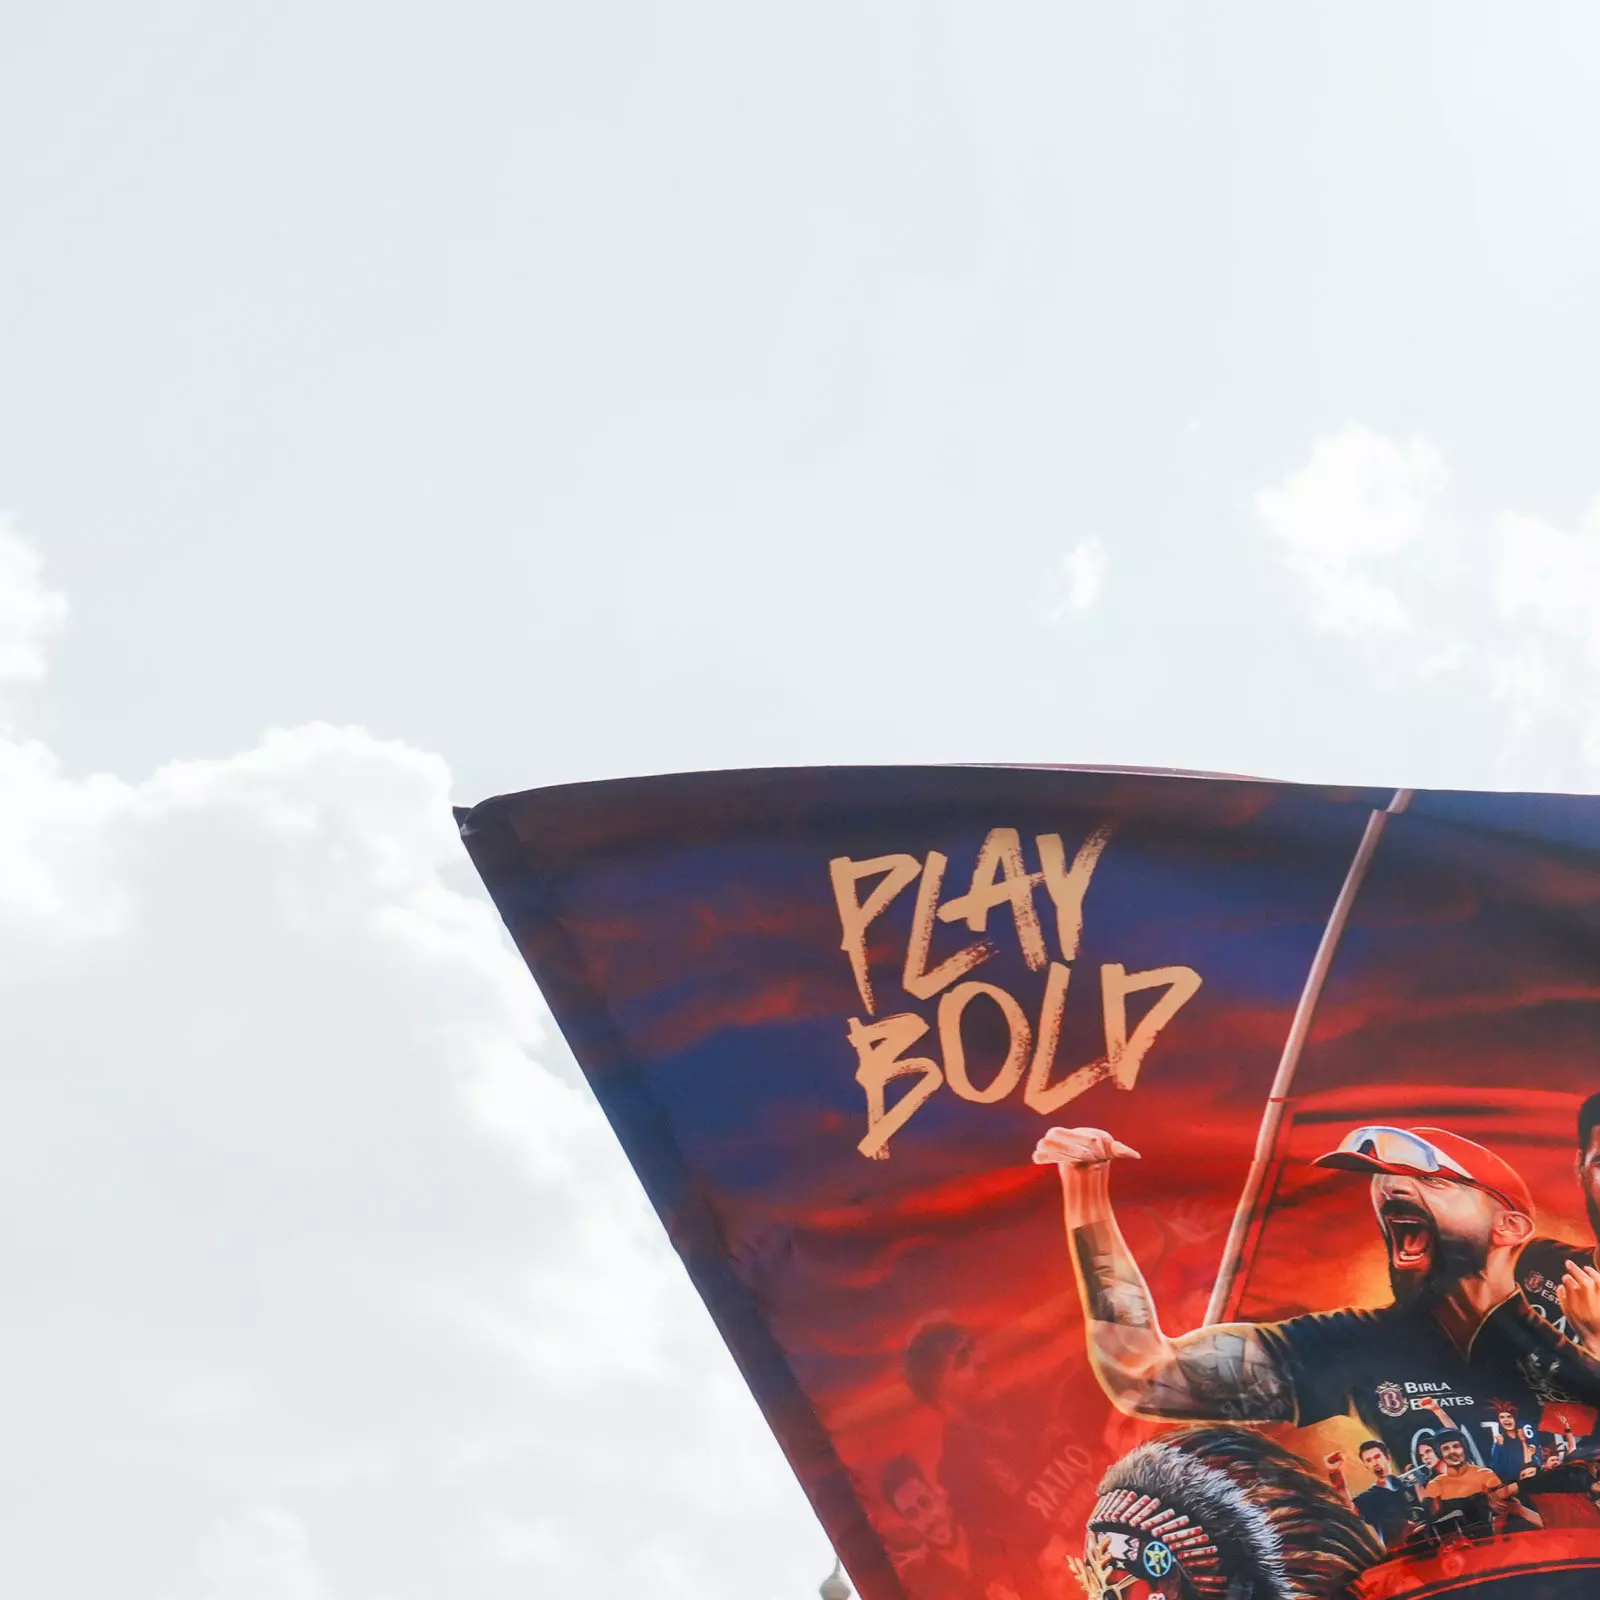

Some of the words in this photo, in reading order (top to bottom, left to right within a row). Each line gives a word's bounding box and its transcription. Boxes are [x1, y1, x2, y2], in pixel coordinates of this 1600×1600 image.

[829, 821, 1113, 1016] PLAY
[846, 962, 1203, 1160] BOLD
[1404, 1381, 1451, 1394] BIRLA
[1410, 1396, 1475, 1411] ETATES
